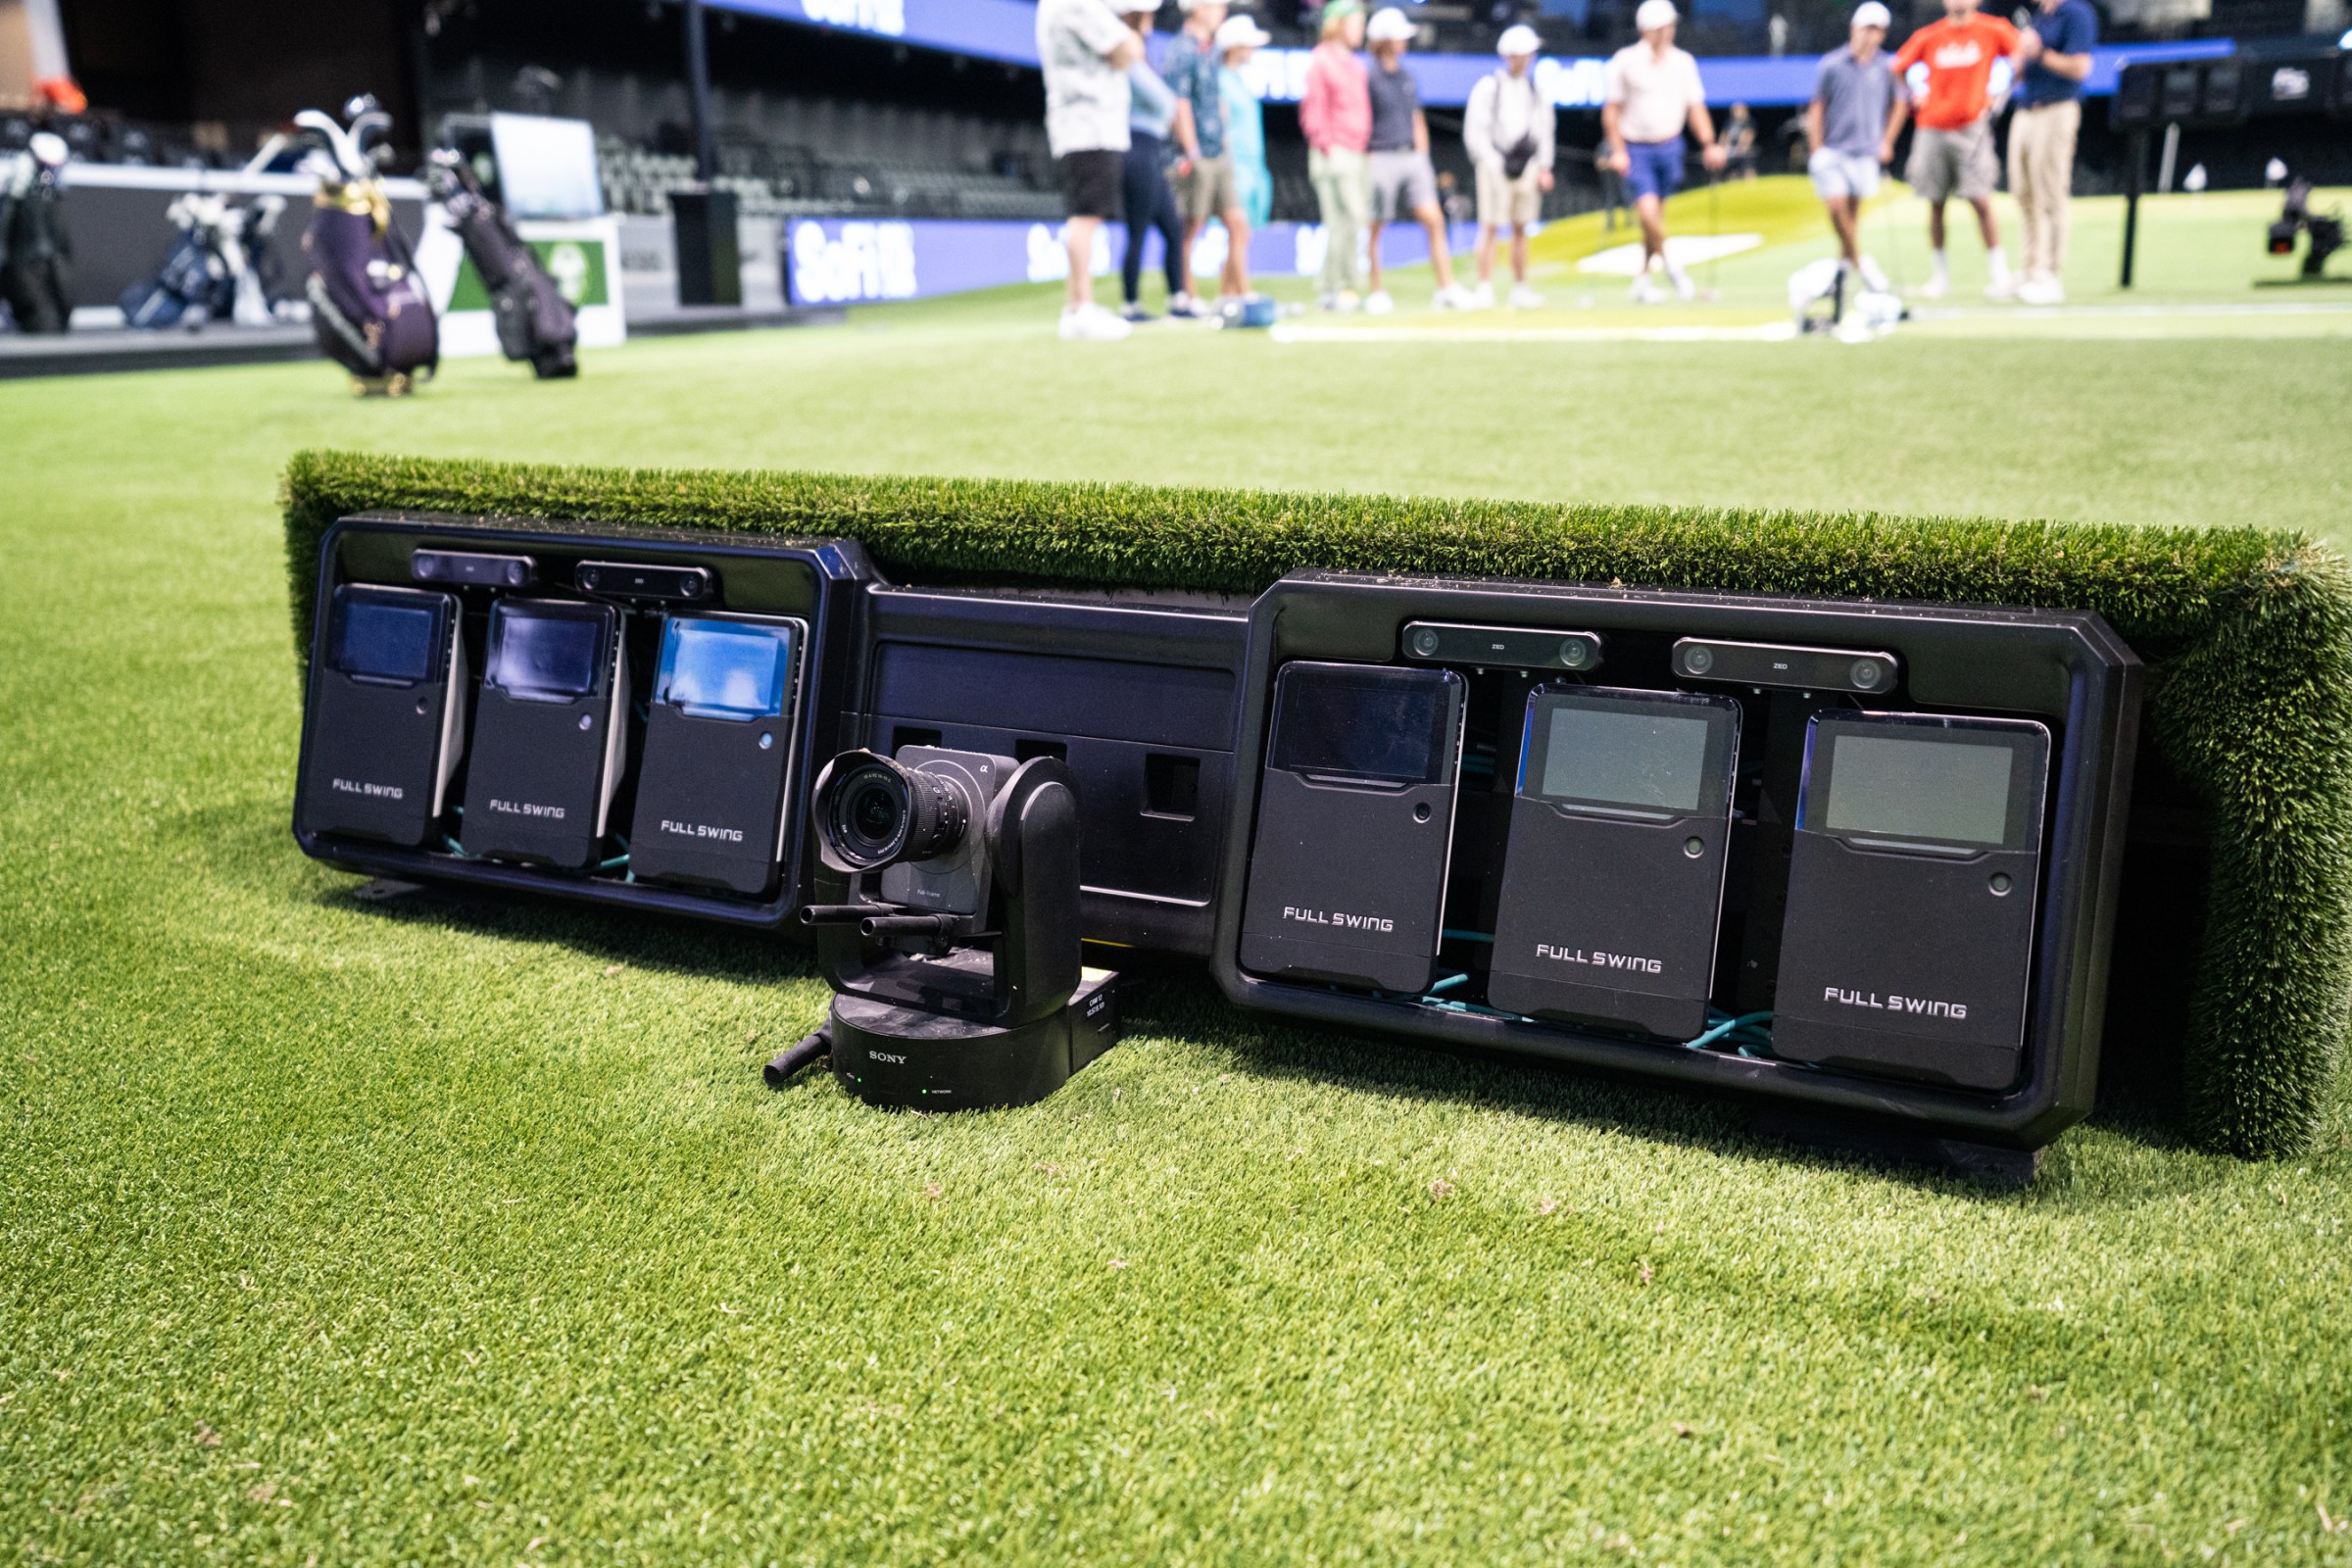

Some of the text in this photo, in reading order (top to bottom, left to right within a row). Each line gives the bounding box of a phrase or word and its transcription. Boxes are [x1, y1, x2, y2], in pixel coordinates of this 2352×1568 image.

[333, 778, 403, 800] FULL SWING
[489, 799, 564, 818] FULL SWING
[661, 819, 743, 842] FULL SWING
[1283, 906, 1394, 933] FULL SWING
[1536, 944, 1662, 974] FULL SWING
[1824, 987, 1967, 1019] FULL SWING
[868, 1050, 907, 1064] SONY
